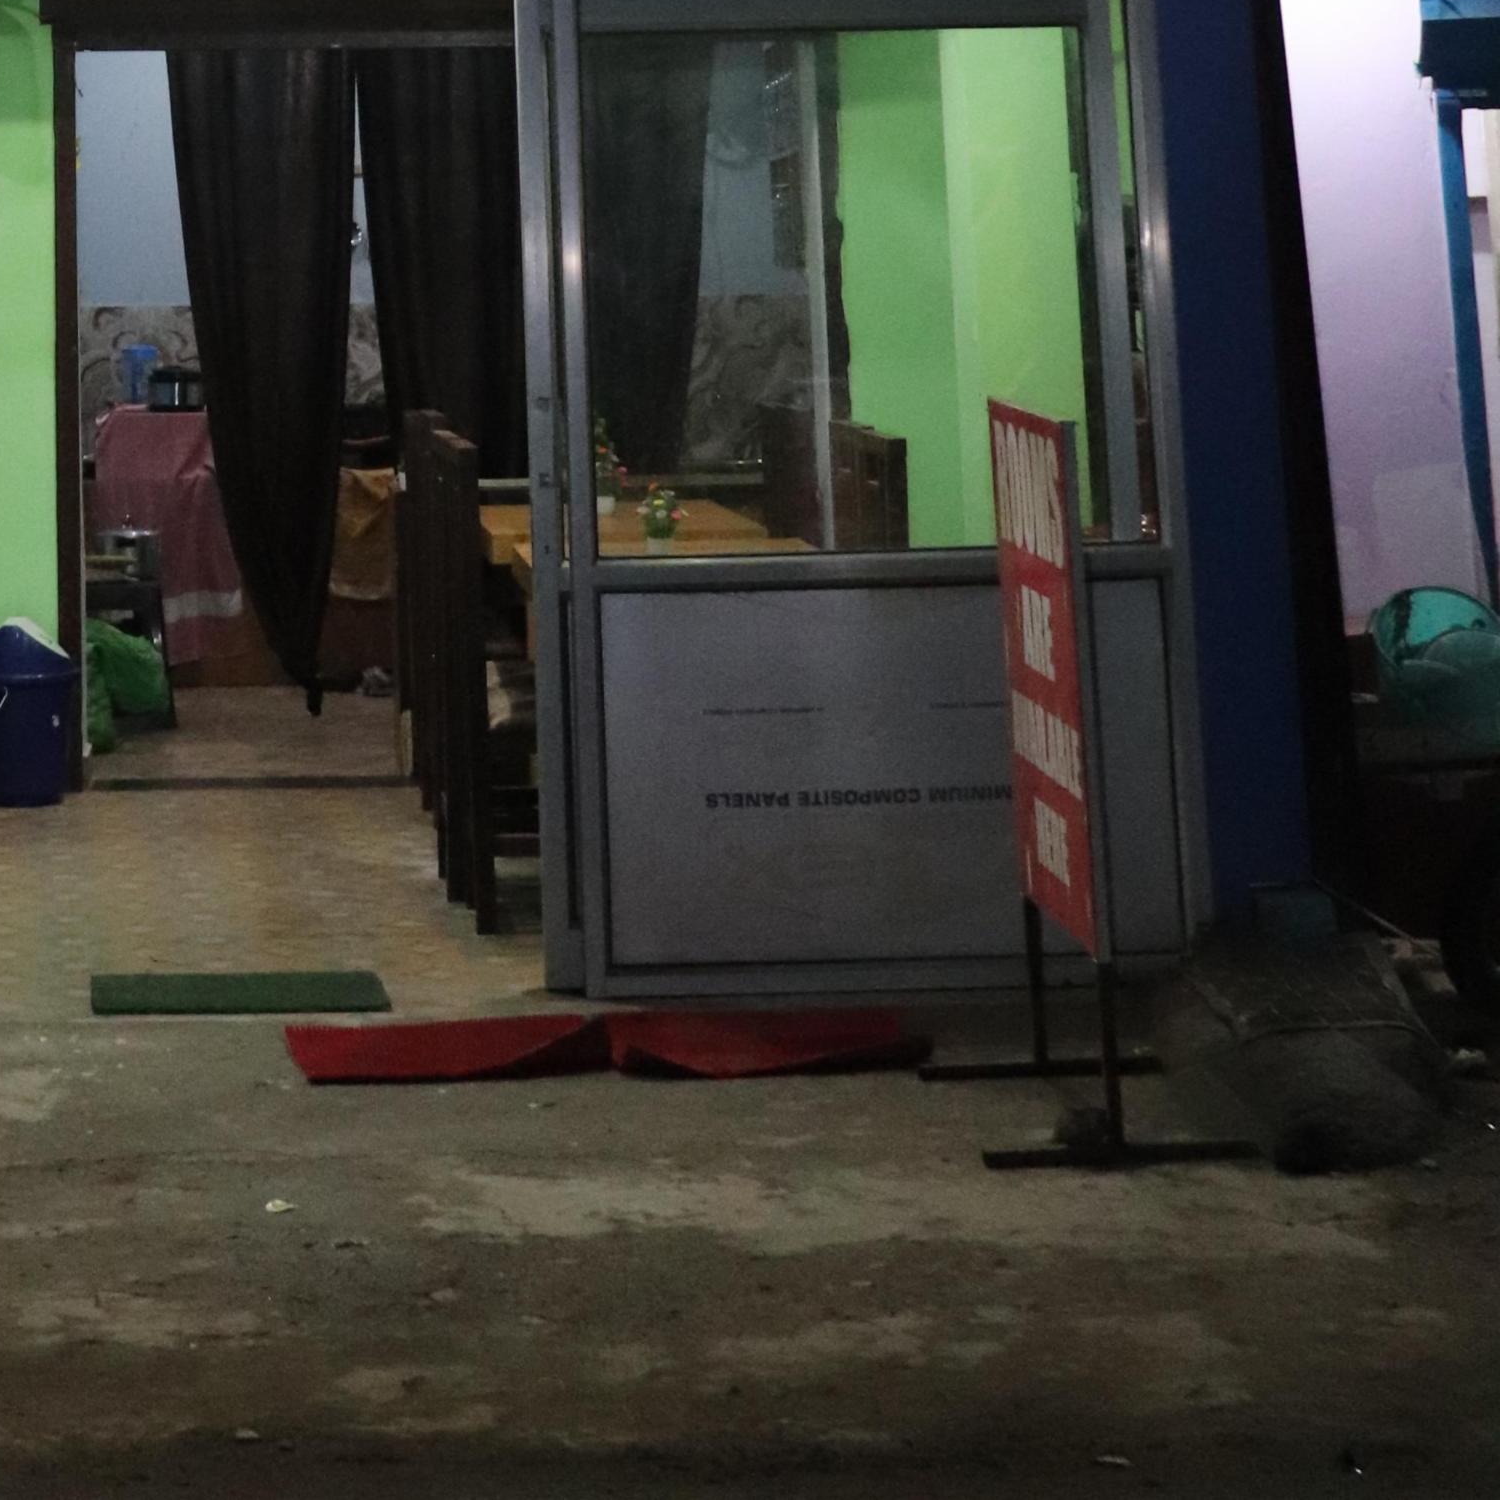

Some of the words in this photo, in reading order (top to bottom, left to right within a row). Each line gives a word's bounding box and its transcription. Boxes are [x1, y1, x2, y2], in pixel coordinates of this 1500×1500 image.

[993, 420, 1064, 569] ROOMS
[705, 792, 790, 809] PANELS
[797, 788, 921, 807] COMPOSITE
[928, 785, 1012, 802] MINIUM
